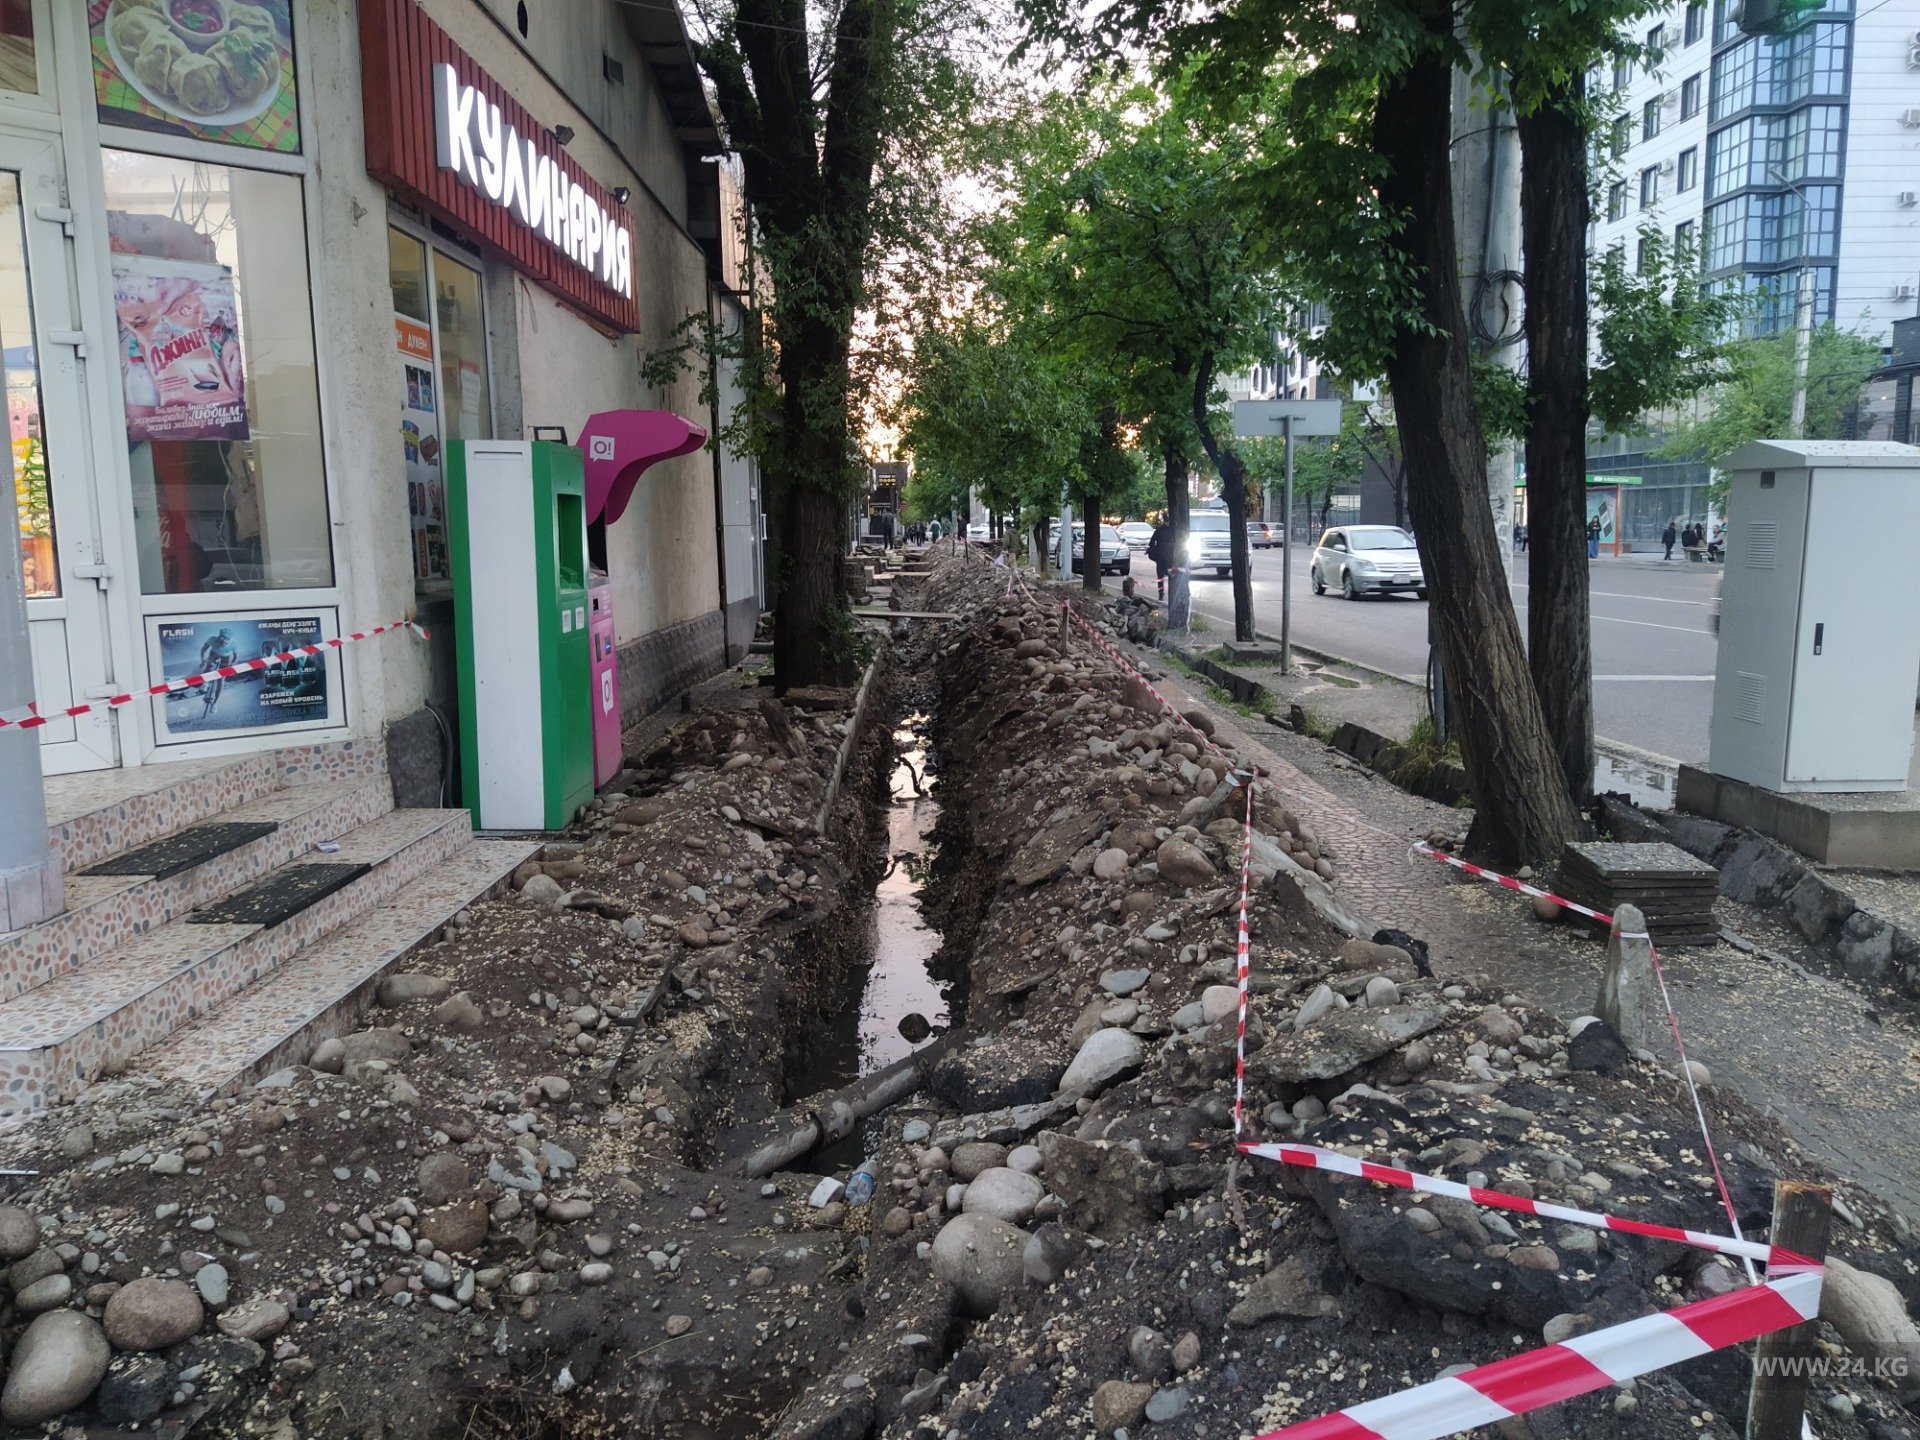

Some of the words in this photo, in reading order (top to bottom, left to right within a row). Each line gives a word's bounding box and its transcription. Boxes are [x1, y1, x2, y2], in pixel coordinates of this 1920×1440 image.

[446, 63, 632, 300] КУЛИНАРИЯ
[162, 629, 194, 637] FLASH
[293, 695, 324, 703] УРОВЕНЬ
